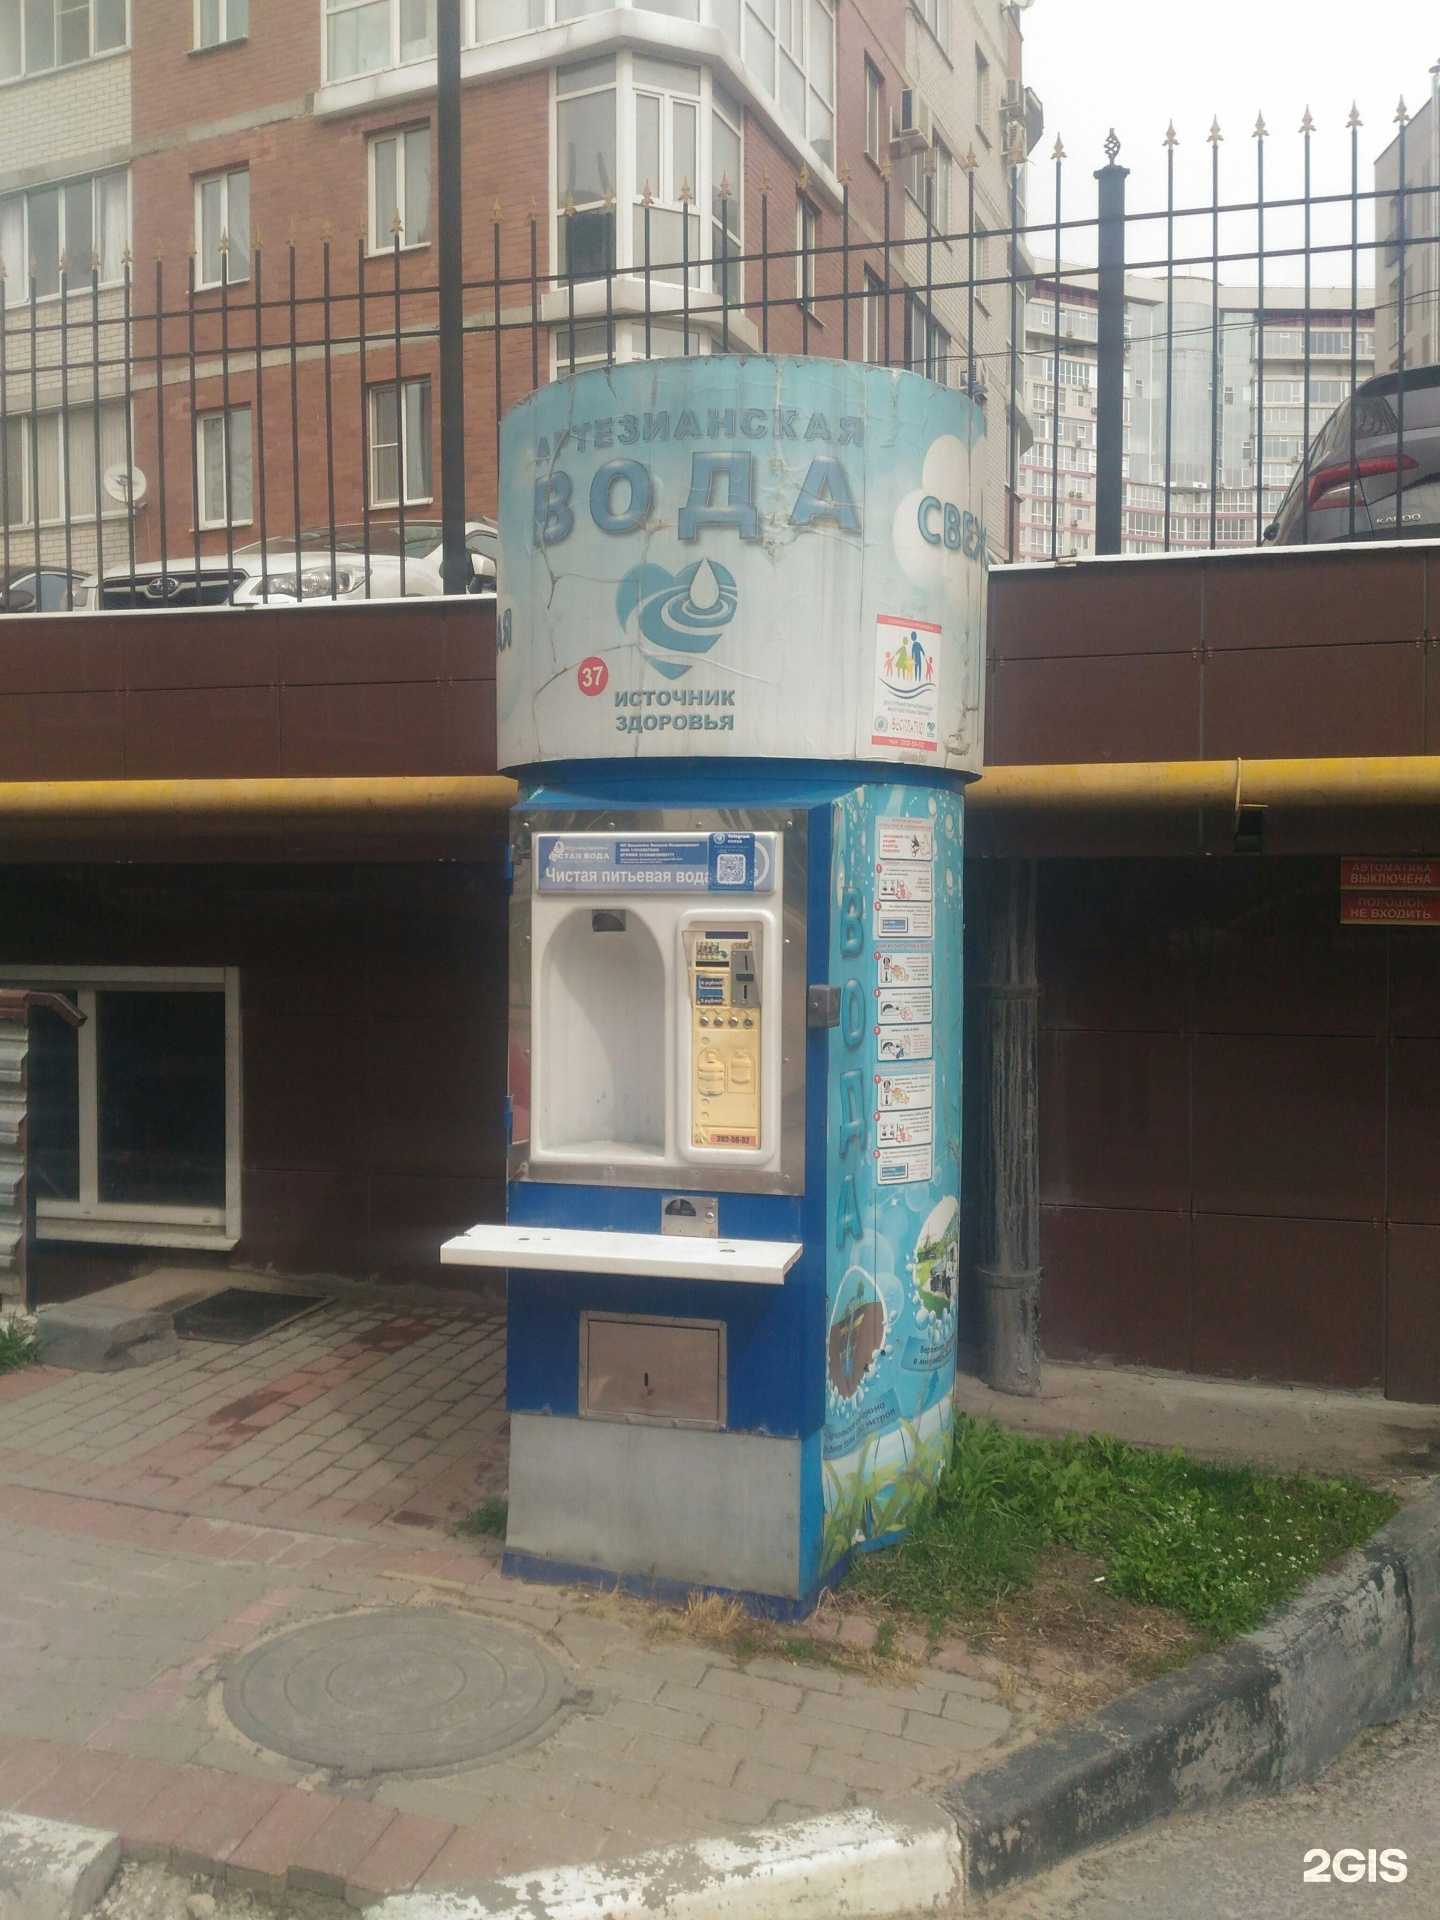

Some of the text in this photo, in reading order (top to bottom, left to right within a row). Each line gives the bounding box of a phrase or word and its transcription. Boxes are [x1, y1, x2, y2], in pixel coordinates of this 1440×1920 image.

[533, 450, 864, 547] ВОДА
[582, 666, 604, 688] 37
[614, 689, 736, 708] ИСТОЧНИК
[615, 714, 735, 734] ЗДОРОВЬЯ
[545, 867, 598, 884] Чистая
[601, 869, 671, 884] питьевая
[1351, 873, 1432, 884] ВЫКЛЮЧЕНА
